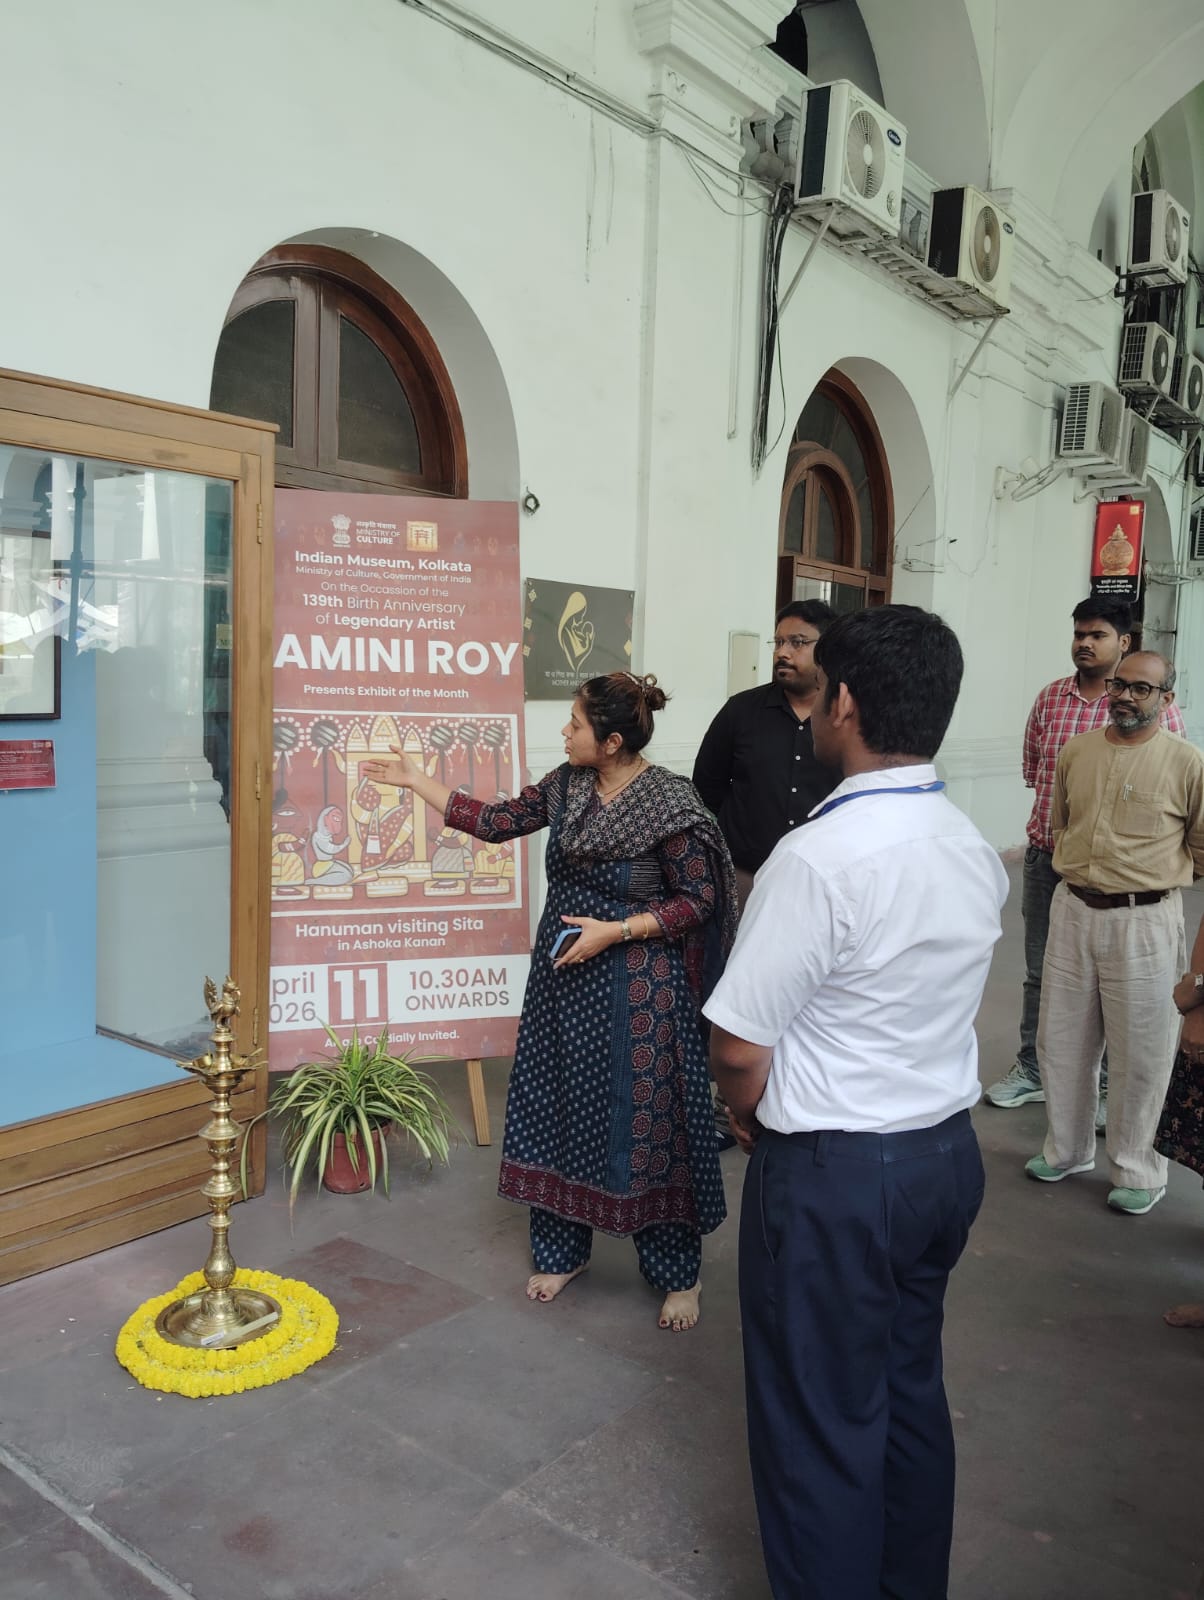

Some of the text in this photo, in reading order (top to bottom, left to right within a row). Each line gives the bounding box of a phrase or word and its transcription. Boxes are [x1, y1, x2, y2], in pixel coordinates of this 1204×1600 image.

[356, 528, 401, 538] MINISTRY OF
[356, 535, 394, 545] CULTURE
[295, 550, 472, 573] Indian Museum, Kolkata
[295, 566, 472, 584] Ministry of Culture, Government of India
[320, 581, 449, 597] On the Occassion of the
[303, 594, 466, 617] 139th Birth Anniversary
[315, 612, 456, 632] of Legendary Artist
[273, 633, 520, 677] AMINI ROY
[303, 684, 470, 699] Presents Exhibit of the Month
[295, 916, 484, 938] Hanuman visiting Sita
[337, 936, 446, 951] in Ashoka Kanan
[272, 971, 315, 1003] pril
[409, 967, 508, 990] 10.30AM
[333, 968, 380, 1021] 11
[405, 990, 510, 1011] ONWARDS
[269, 1001, 316, 1024] 026
[418, 1029, 460, 1041] Invited.
